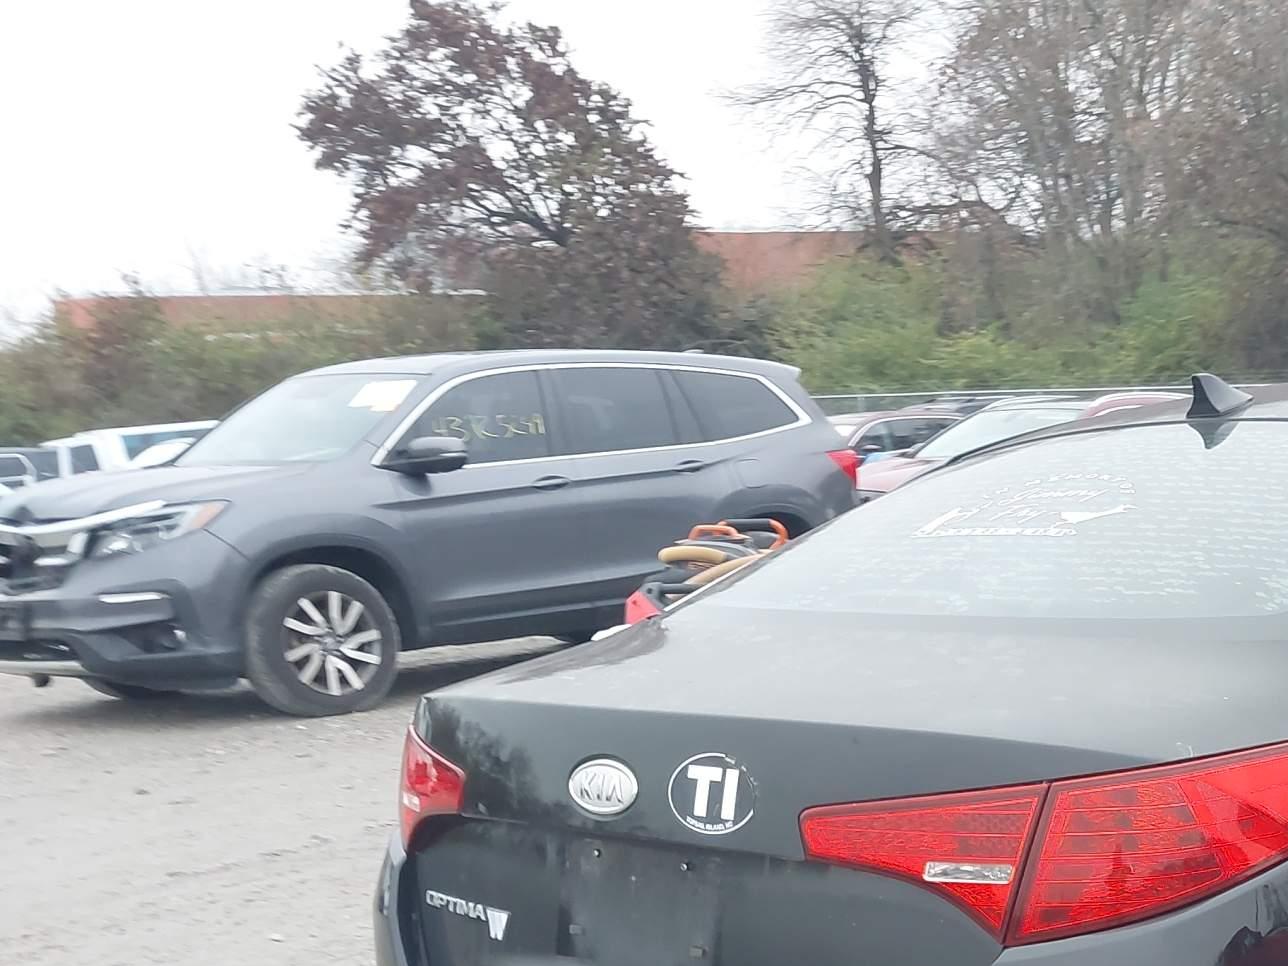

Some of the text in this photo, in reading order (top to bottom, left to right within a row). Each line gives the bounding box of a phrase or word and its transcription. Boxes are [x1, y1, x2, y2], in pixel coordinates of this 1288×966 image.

[578, 771, 625, 804] KIA
[687, 764, 740, 821] TI
[425, 889, 487, 922] OPTIMA
